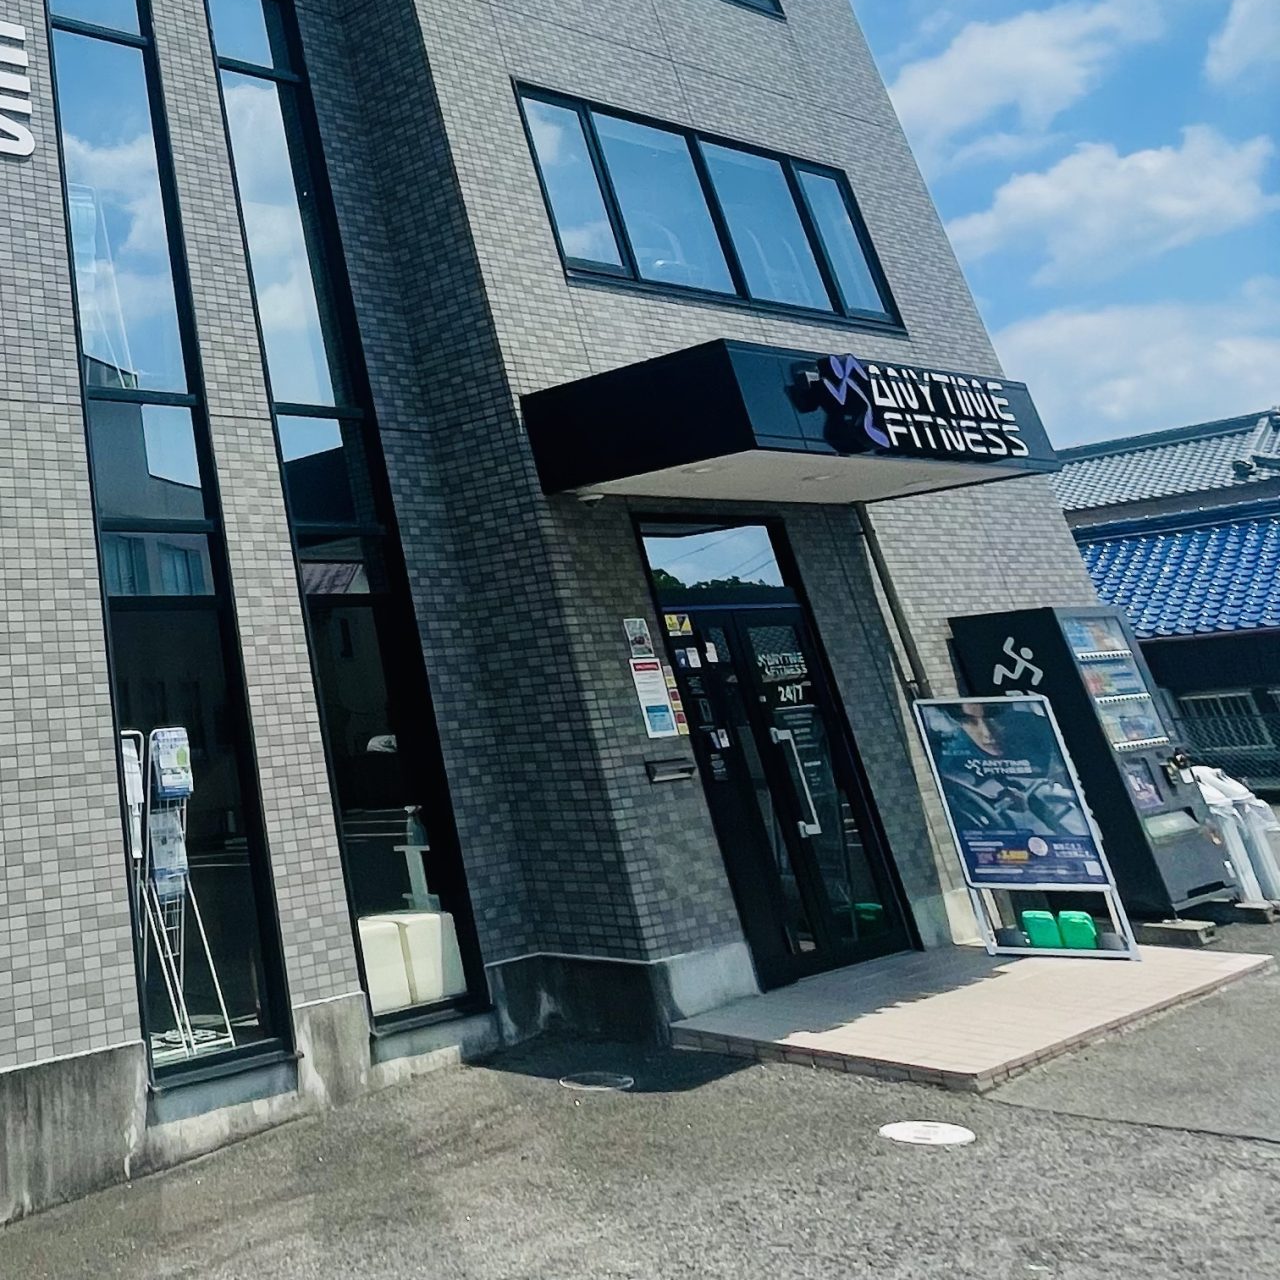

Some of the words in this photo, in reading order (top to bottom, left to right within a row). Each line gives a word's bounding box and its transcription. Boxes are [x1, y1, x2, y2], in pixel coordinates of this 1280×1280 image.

[868, 365, 1016, 422] ANYTIME
[883, 412, 1030, 457] FITNESS
[778, 683, 803, 704] 24/7
